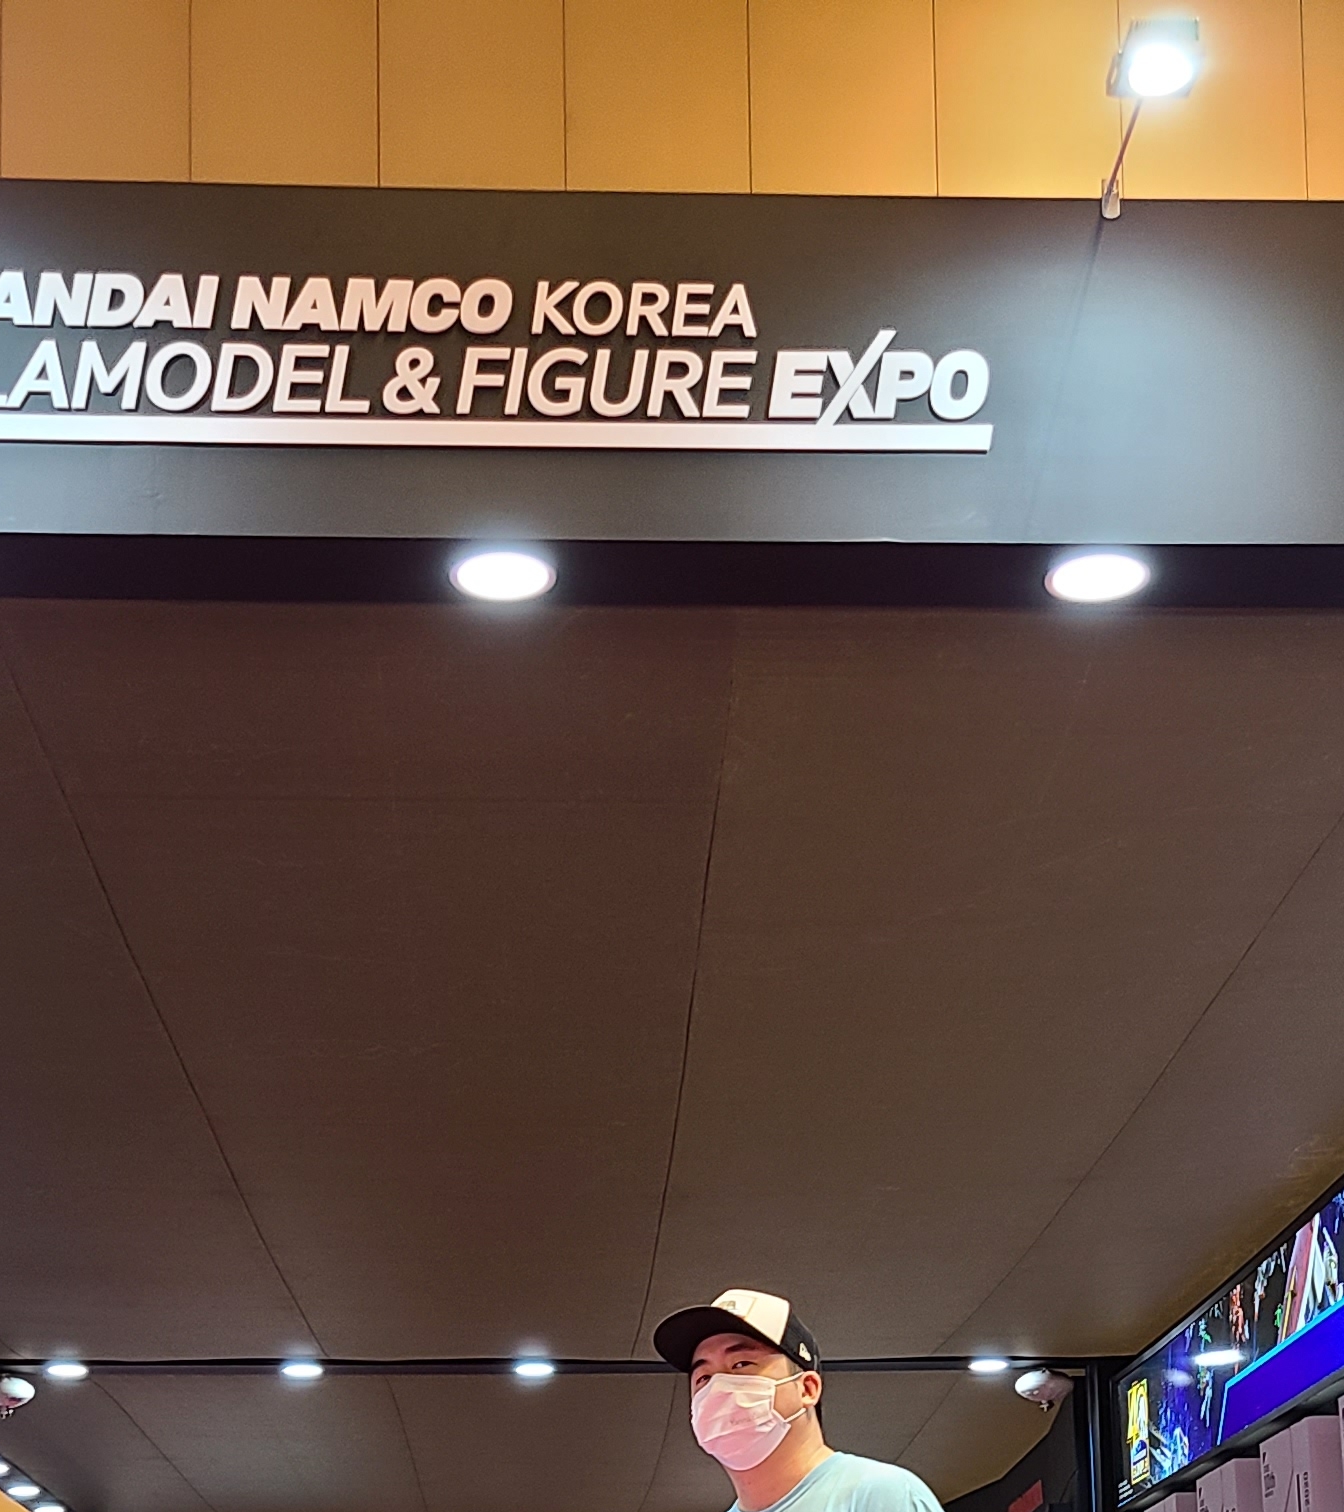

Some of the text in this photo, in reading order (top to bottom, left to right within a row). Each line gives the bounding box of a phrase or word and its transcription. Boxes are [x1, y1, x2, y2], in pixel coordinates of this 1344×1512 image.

[230, 275, 513, 334] NAMCO
[531, 280, 758, 339] KOREA
[383, 349, 442, 417] &
[455, 347, 759, 420] FIGURE
[768, 329, 992, 427] EXPO
